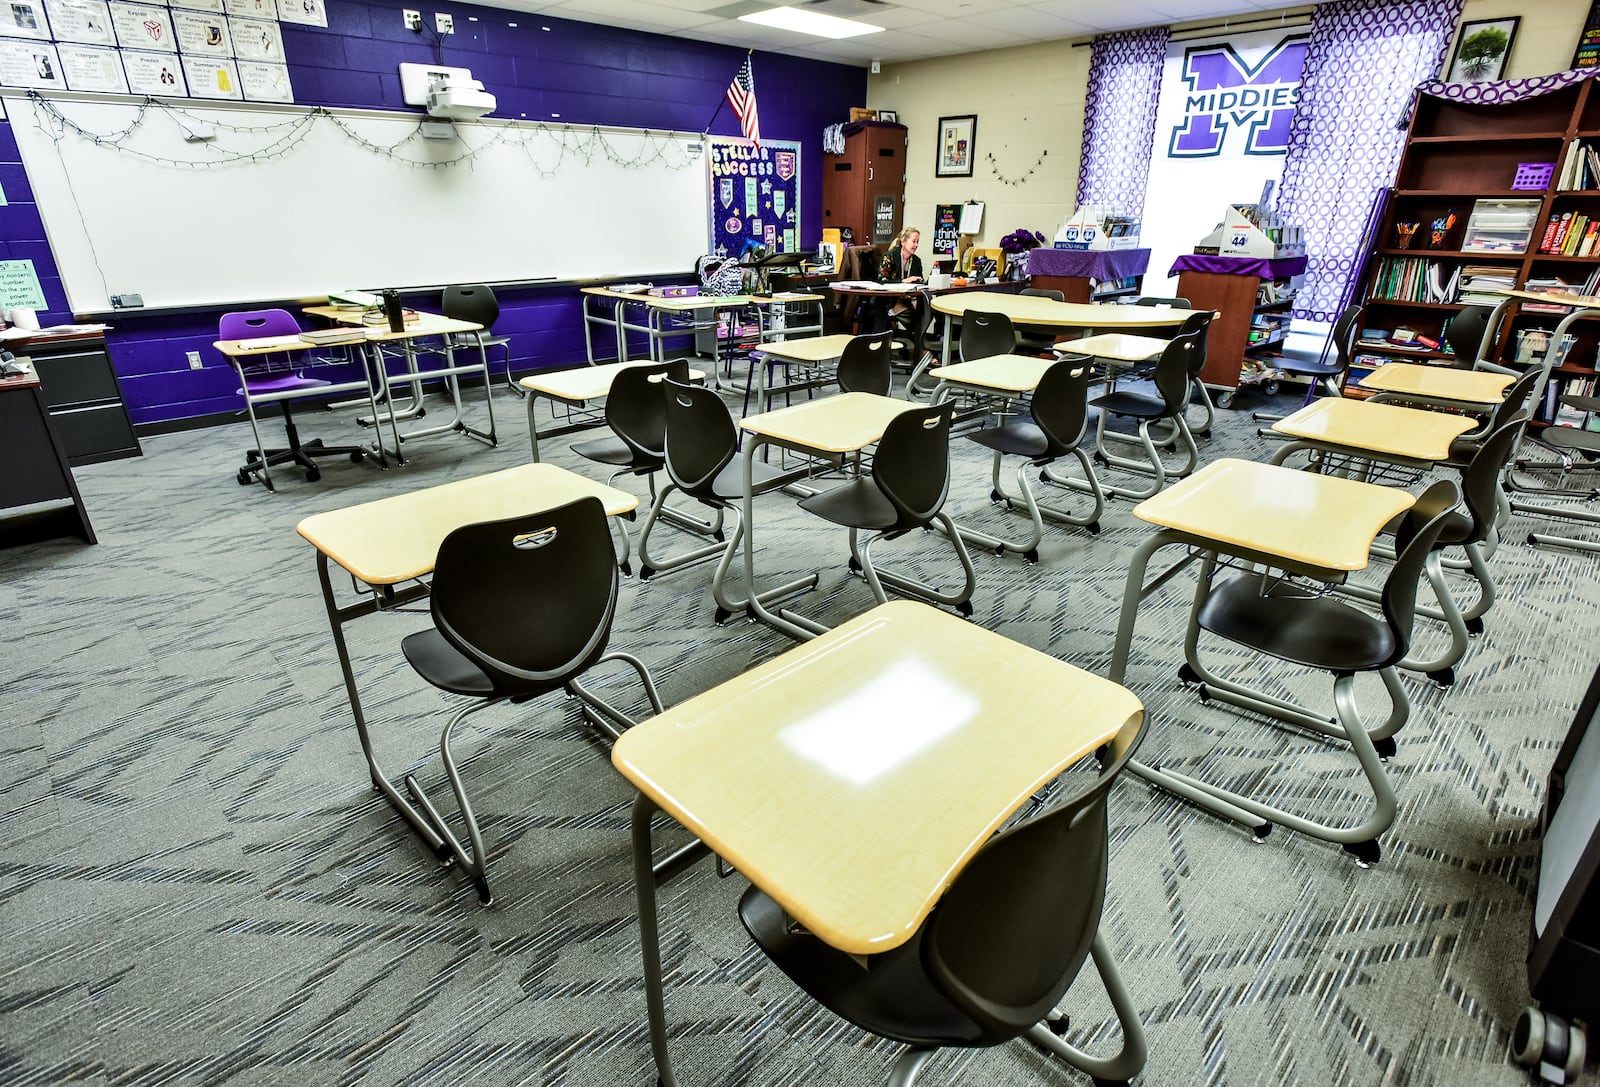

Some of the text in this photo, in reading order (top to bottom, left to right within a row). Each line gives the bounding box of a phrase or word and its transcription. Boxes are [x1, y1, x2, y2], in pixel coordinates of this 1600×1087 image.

[1579, 57, 1598, 65] MIND
[1185, 87, 1301, 112] MIDDIES
[712, 146, 769, 162] STELLAR
[713, 161, 773, 176] SUCCESS
[876, 212, 893, 220] word
[938, 227, 958, 239] think
[1231, 236, 1246, 246] 44
